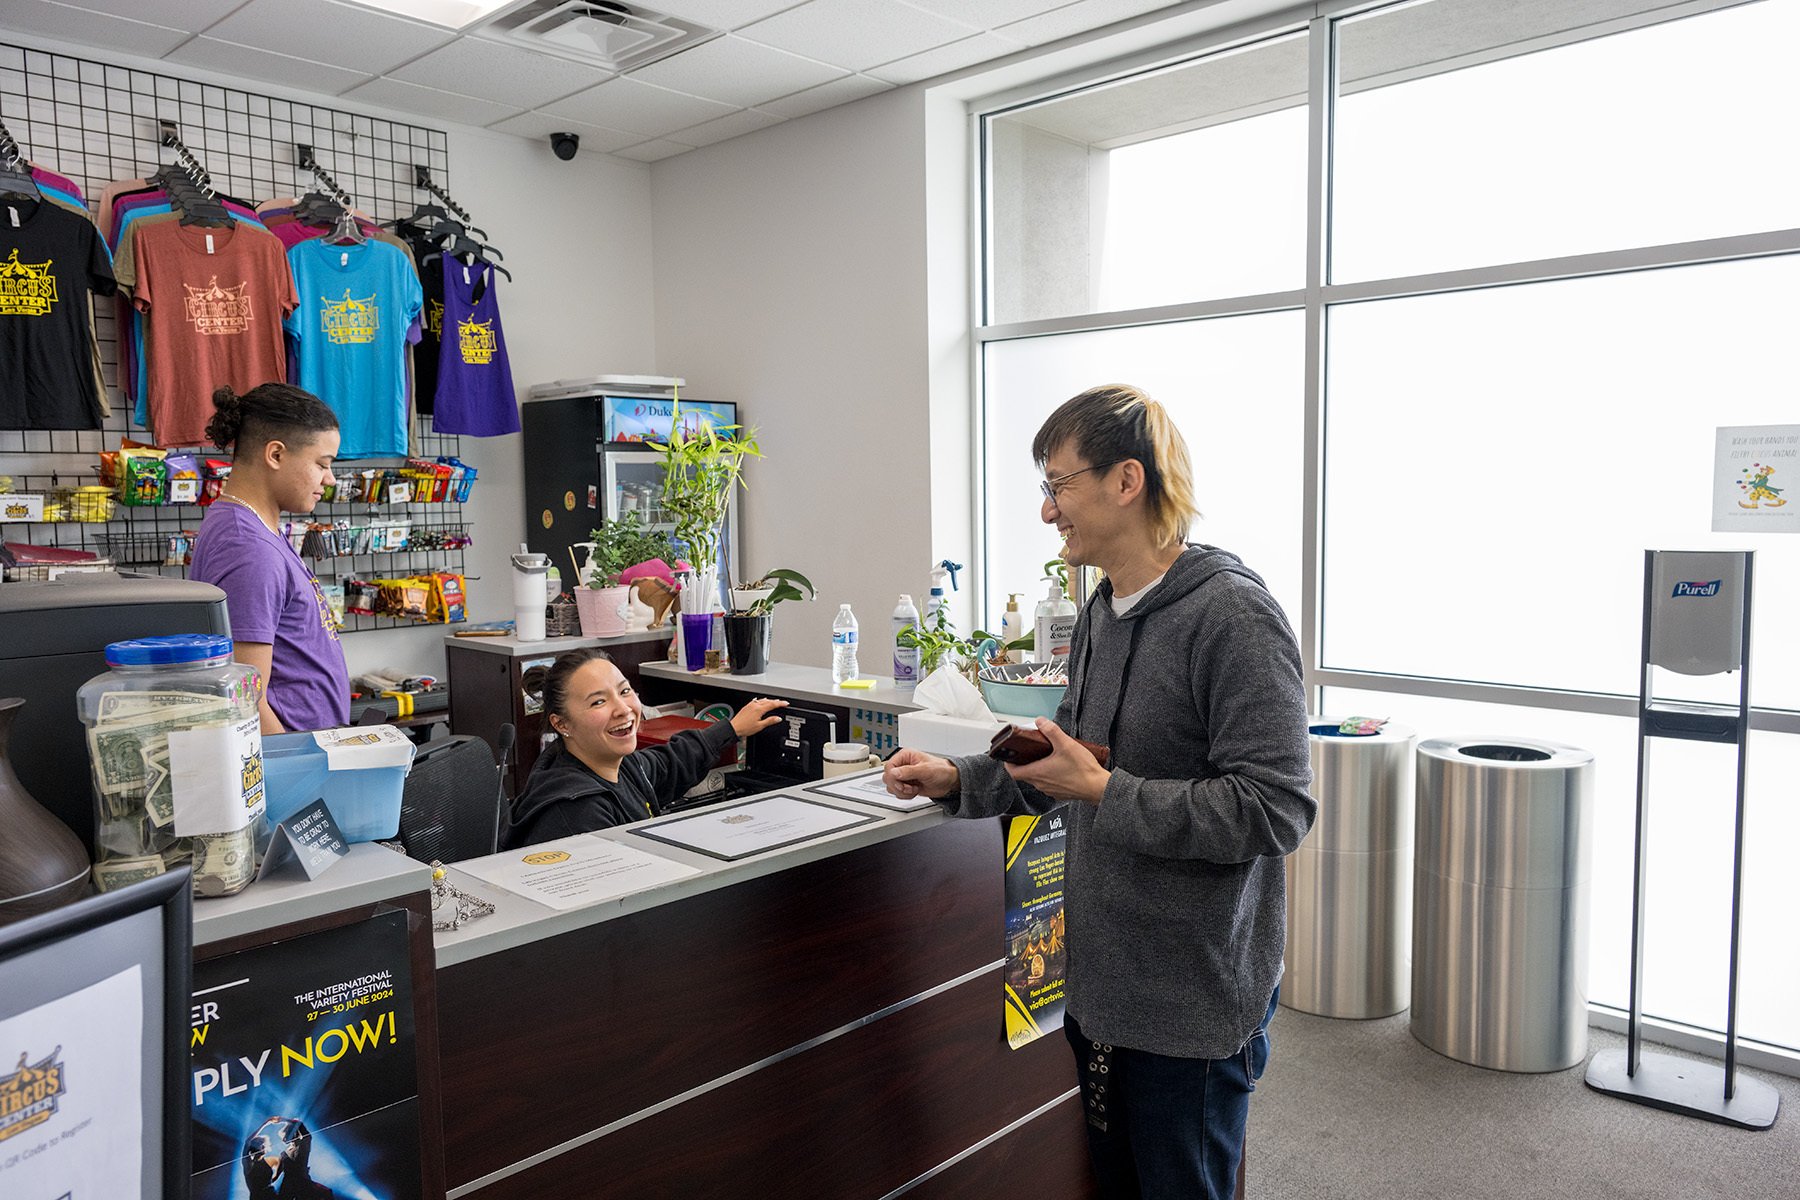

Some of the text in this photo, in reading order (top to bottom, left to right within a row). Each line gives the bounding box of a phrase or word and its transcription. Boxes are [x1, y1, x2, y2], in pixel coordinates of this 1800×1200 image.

[188, 297, 248, 318] CIRCUS
[197, 316, 245, 327] CENTER
[324, 308, 374, 329] CIRCUS
[330, 327, 373, 337] CENTER
[1677, 582, 1716, 595] Purell
[291, 822, 303, 834] YOU
[311, 808, 324, 821] HAVE
[303, 831, 312, 842] BE
[309, 823, 324, 838] CRAZY
[527, 853, 563, 863] STOP
[293, 969, 393, 1005] THE INTERNATIONAL
[310, 979, 393, 1010] VARIETY FESTIVAL
[306, 1010, 319, 1022] 27
[332, 1003, 345, 1014] 30
[345, 995, 370, 1012] JUNE
[371, 989, 394, 1003] 2024
[280, 1010, 397, 1079] NOW!
